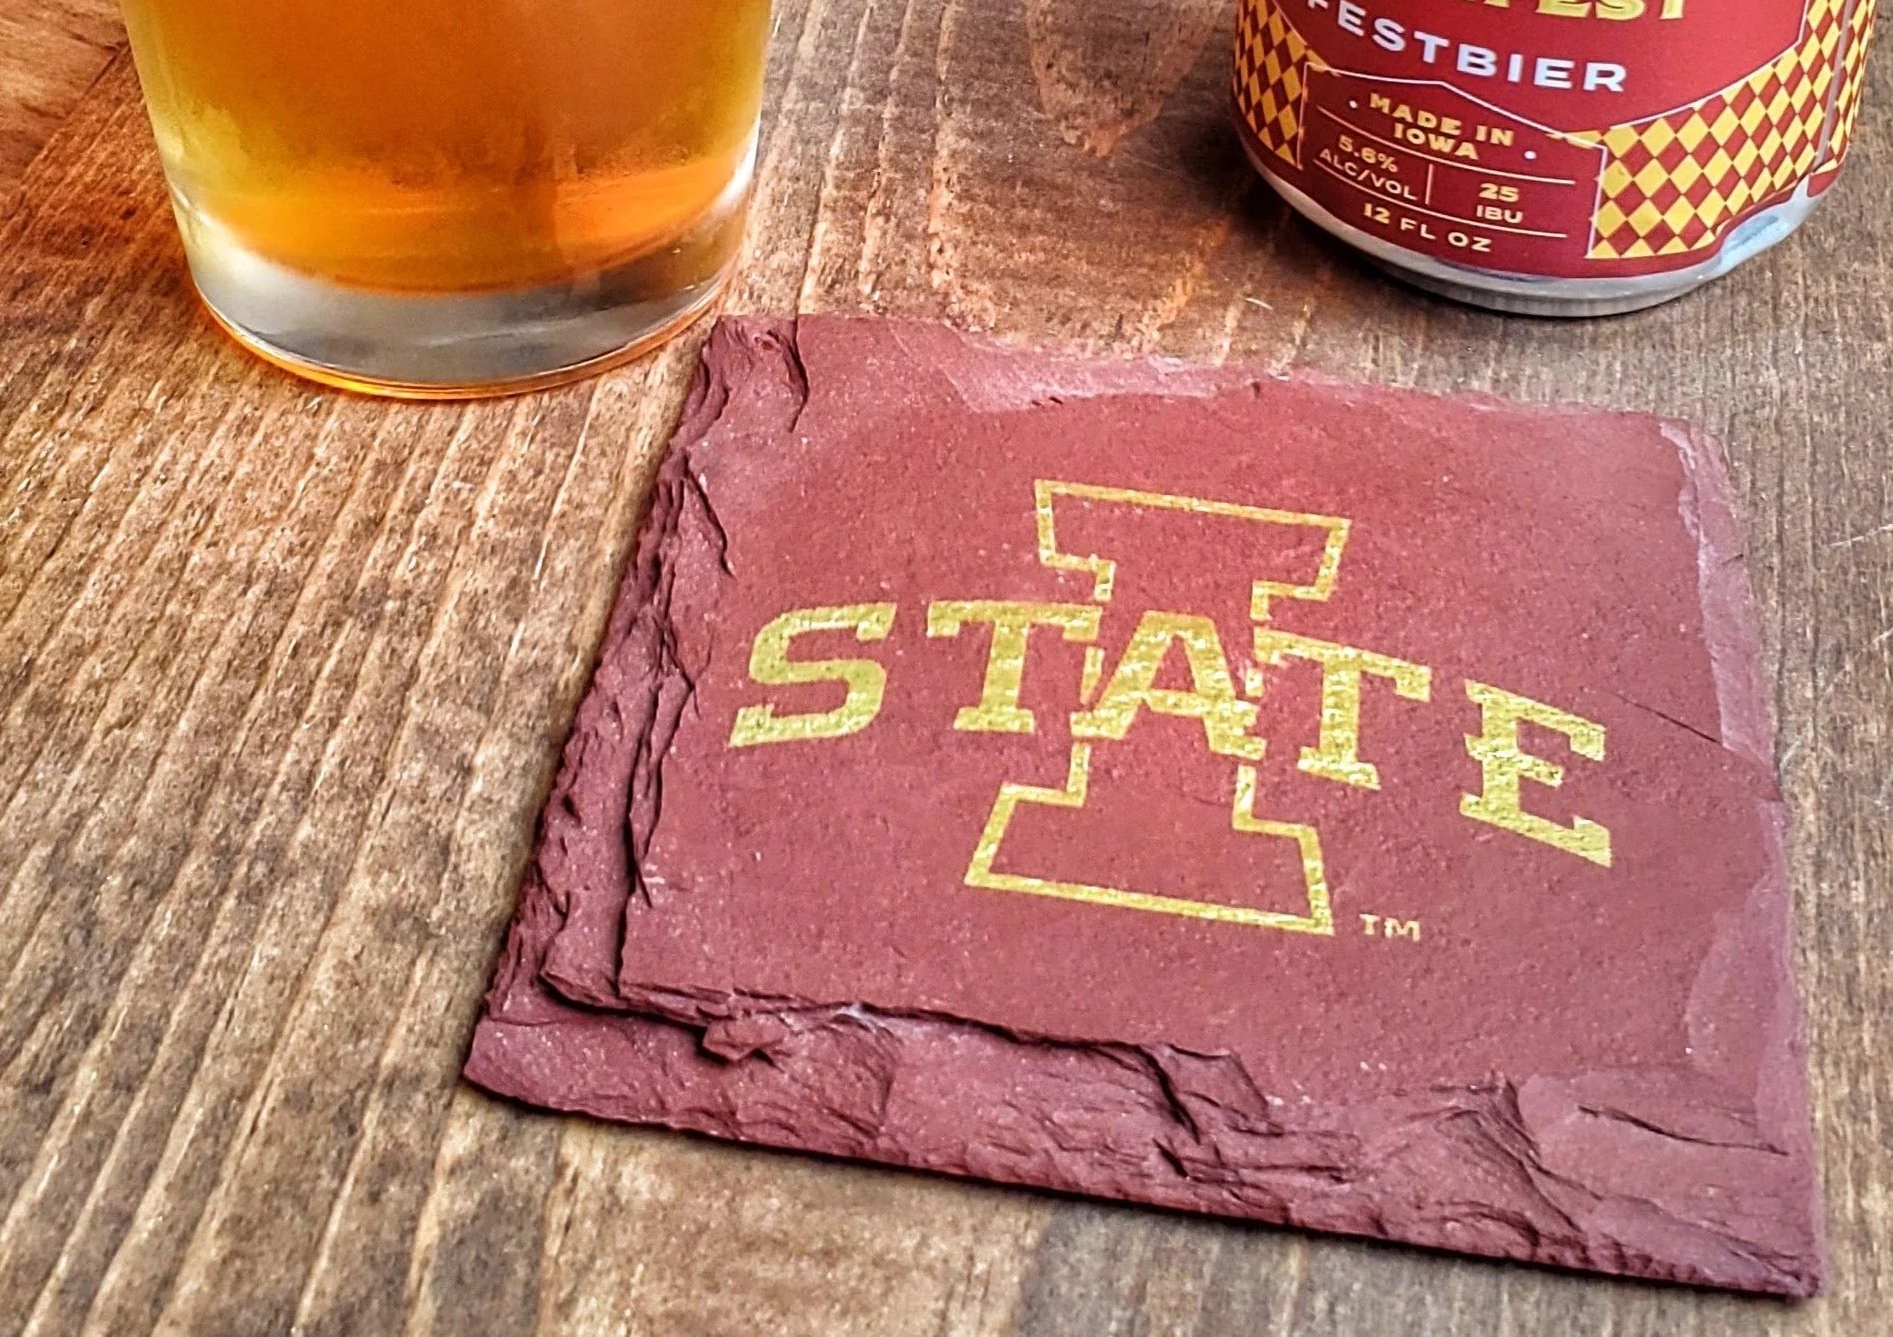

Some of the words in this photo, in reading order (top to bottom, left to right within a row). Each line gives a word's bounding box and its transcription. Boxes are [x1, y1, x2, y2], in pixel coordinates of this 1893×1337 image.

[1370, 93, 1461, 135] MADE
[1475, 124, 1515, 147] IN
[1338, 134, 1398, 174] 5.6%
[1393, 122, 1479, 161] IOWA
[1319, 148, 1419, 202] ALC/VOL
[1478, 182, 1519, 203] 25
[1363, 202, 1391, 225] 12
[1400, 217, 1437, 240] FL
[1447, 231, 1493, 253] OZ
[1475, 204, 1523, 225] IBU
[728, 599, 1612, 869] STATE
[1359, 913, 1422, 942] TM
